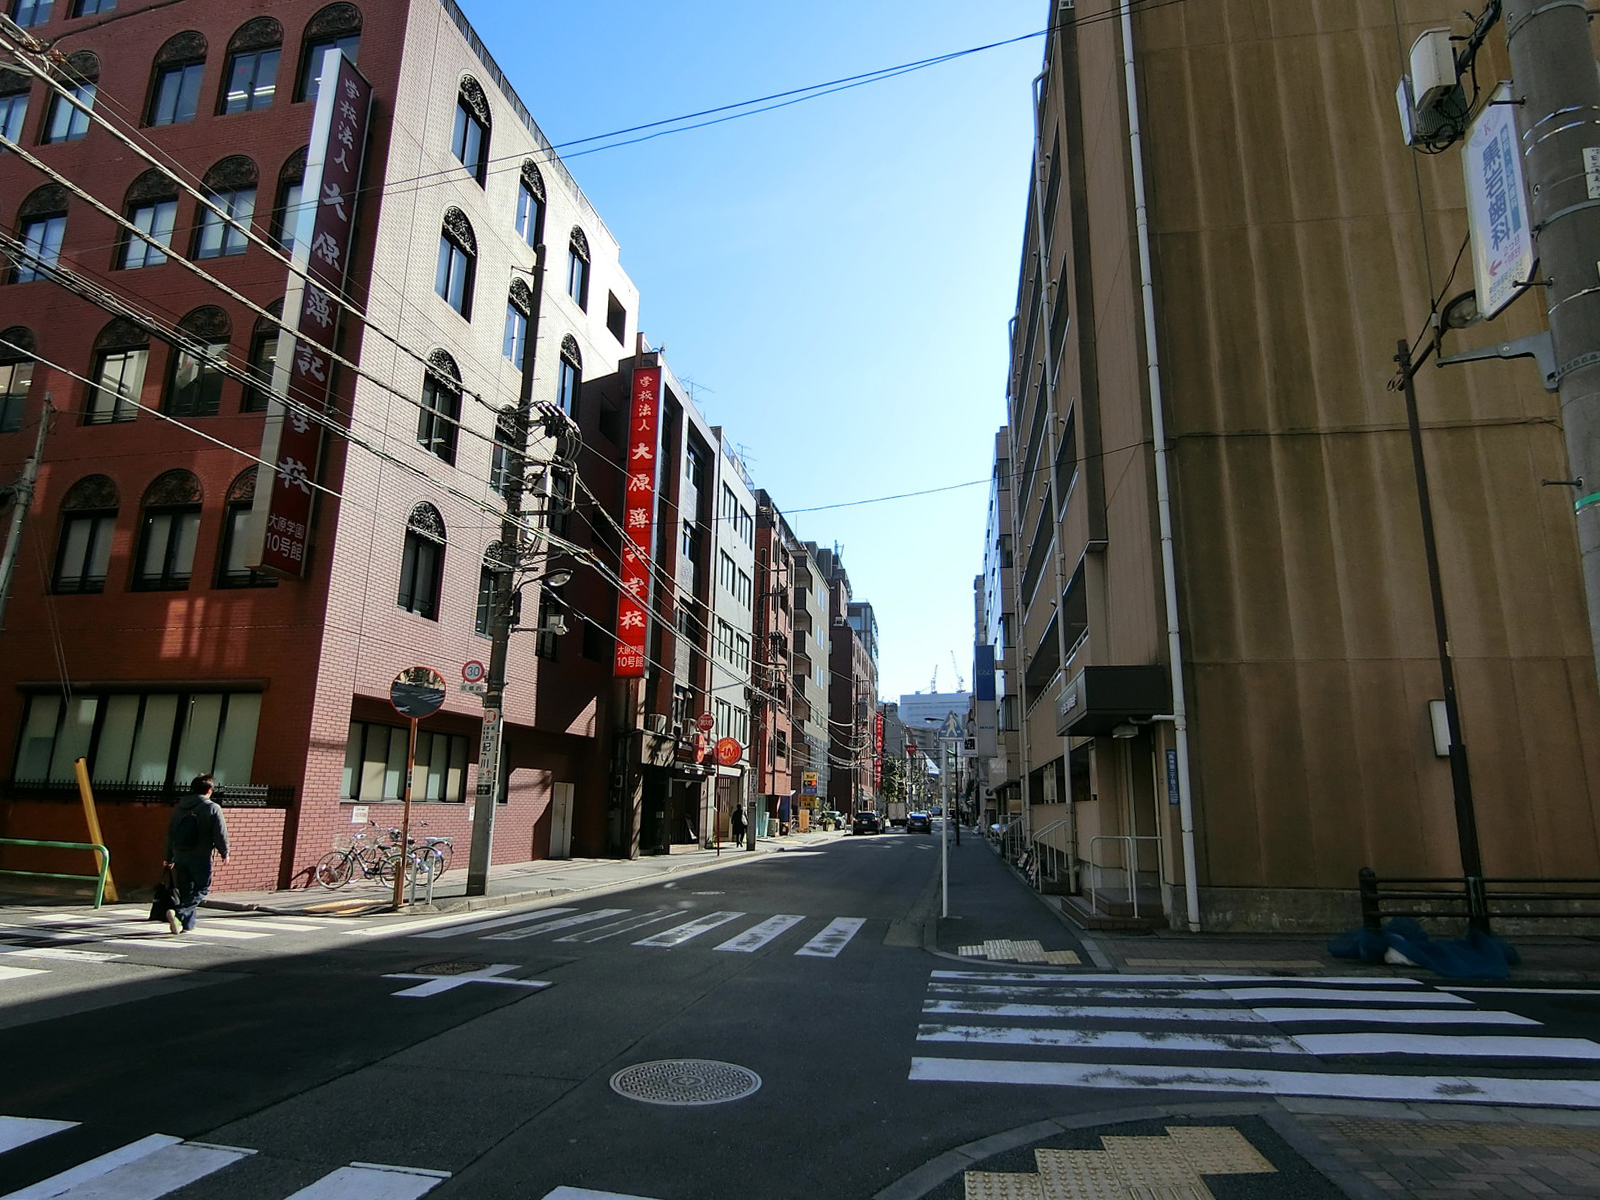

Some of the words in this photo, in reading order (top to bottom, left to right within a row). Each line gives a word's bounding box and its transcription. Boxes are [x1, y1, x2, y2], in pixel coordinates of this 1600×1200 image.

[334, 77, 360, 173] 学校法人
[1482, 136, 1510, 251] 黒岩歯科
[637, 375, 654, 432] 学校法人
[268, 514, 305, 539] 大原学園
[266, 531, 303, 561] 10号館
[616, 656, 644, 668] 10号館
[617, 645, 644, 655] 大原学園
[467, 666, 481, 677] 30
